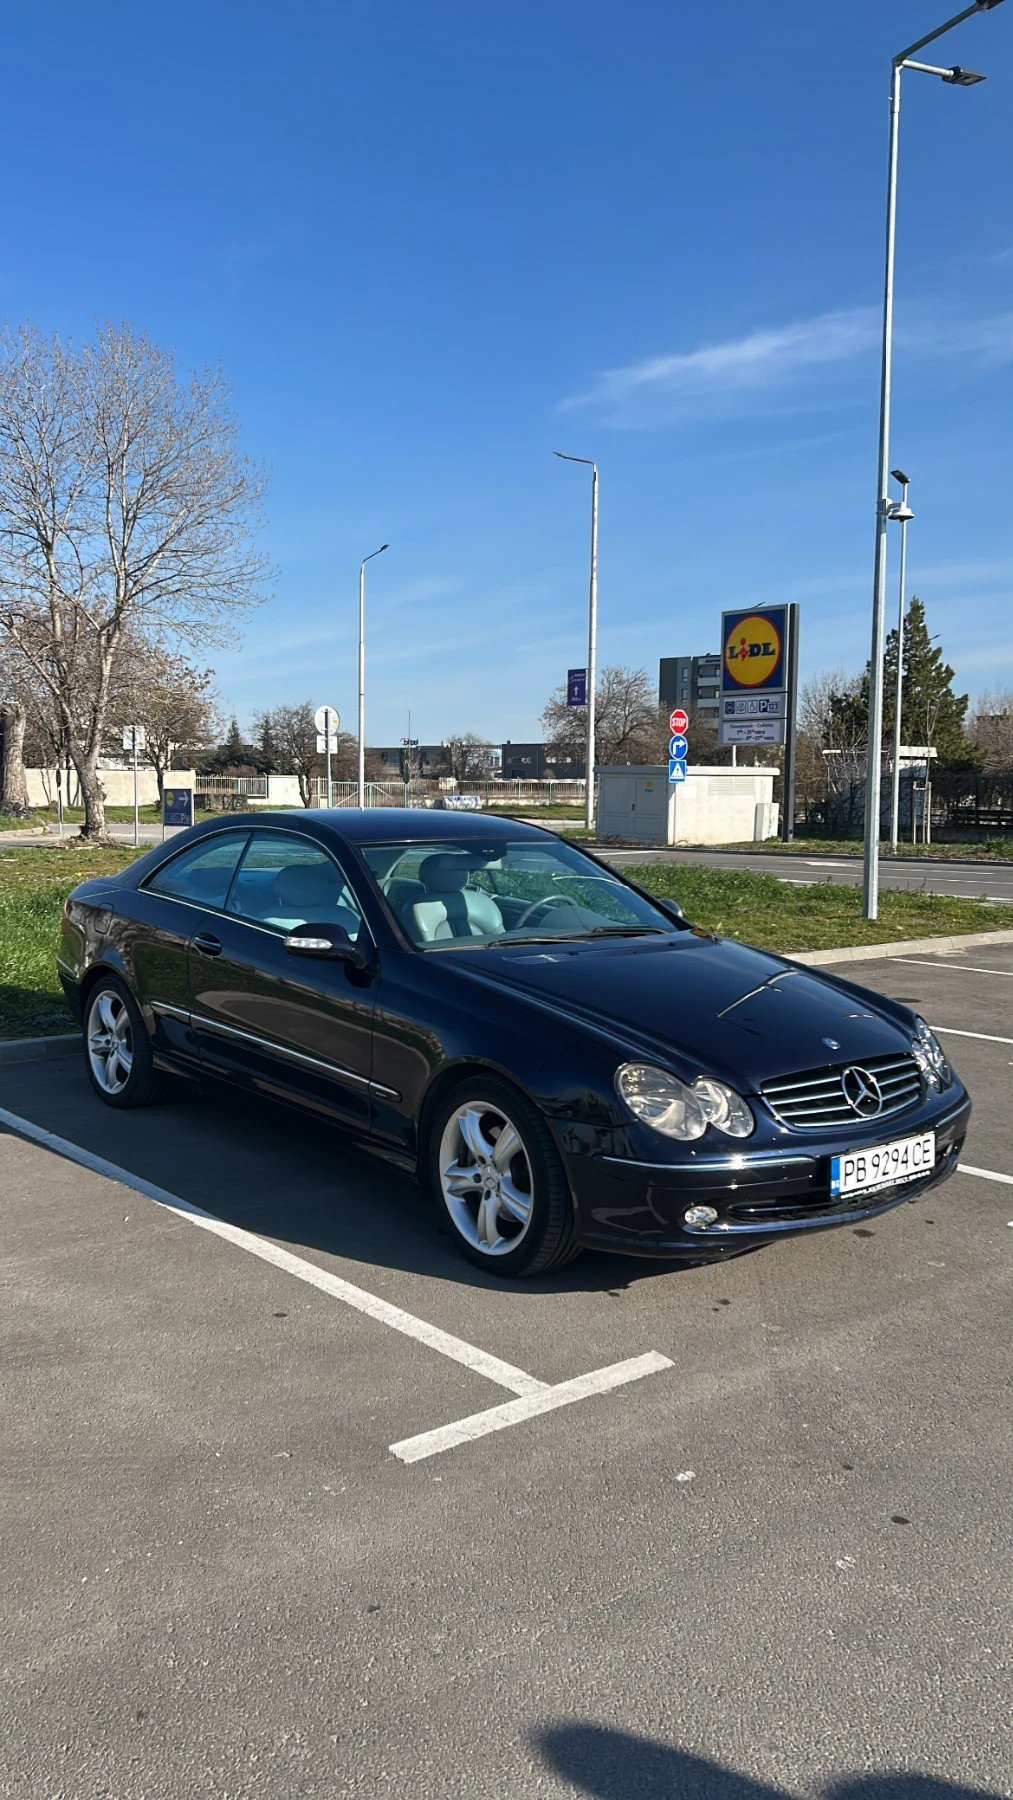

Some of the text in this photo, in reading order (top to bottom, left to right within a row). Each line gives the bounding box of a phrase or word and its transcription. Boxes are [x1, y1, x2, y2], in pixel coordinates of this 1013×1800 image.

[671, 717, 686, 727] STOP
[844, 1157, 866, 1186] PB
[871, 1145, 909, 1179] 9294
[912, 1139, 931, 1166] CE
